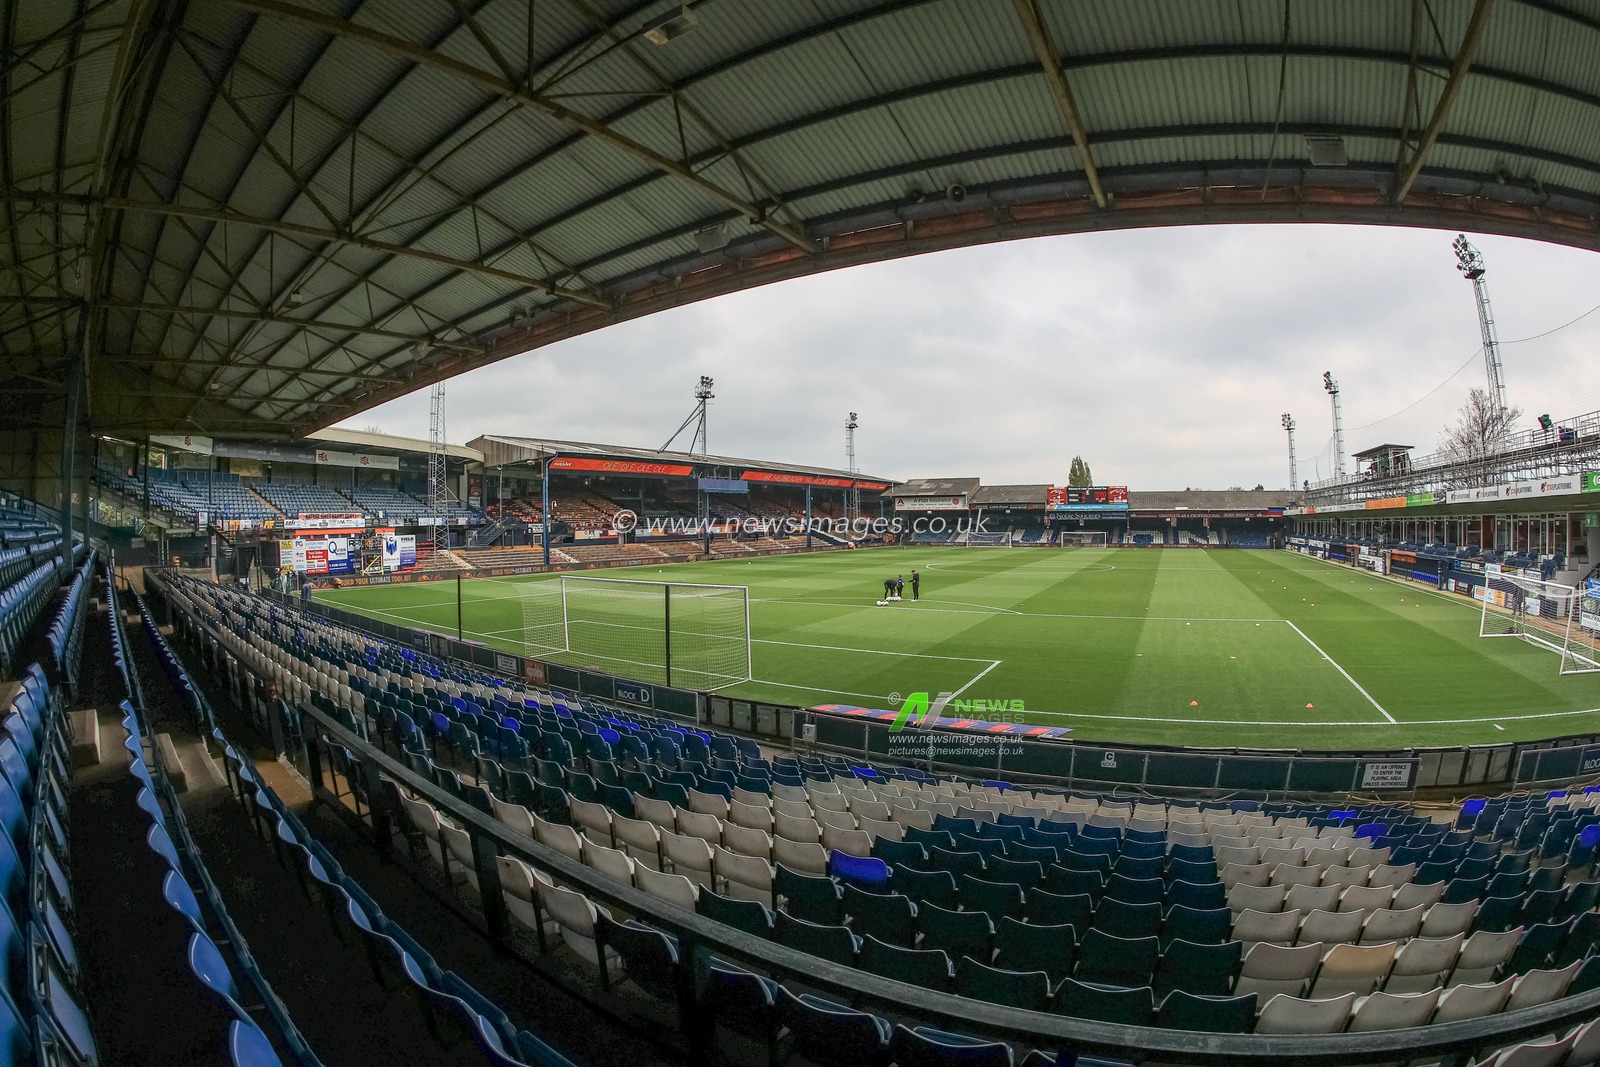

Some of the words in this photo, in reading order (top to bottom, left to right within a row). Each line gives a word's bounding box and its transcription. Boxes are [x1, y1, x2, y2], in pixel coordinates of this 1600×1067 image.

[355, 577, 368, 585] YOUR
[369, 576, 391, 584] ULTIMATE
[391, 575, 403, 583] TOOL
[618, 689, 637, 700] BLOCK
[640, 688, 650, 703] D
